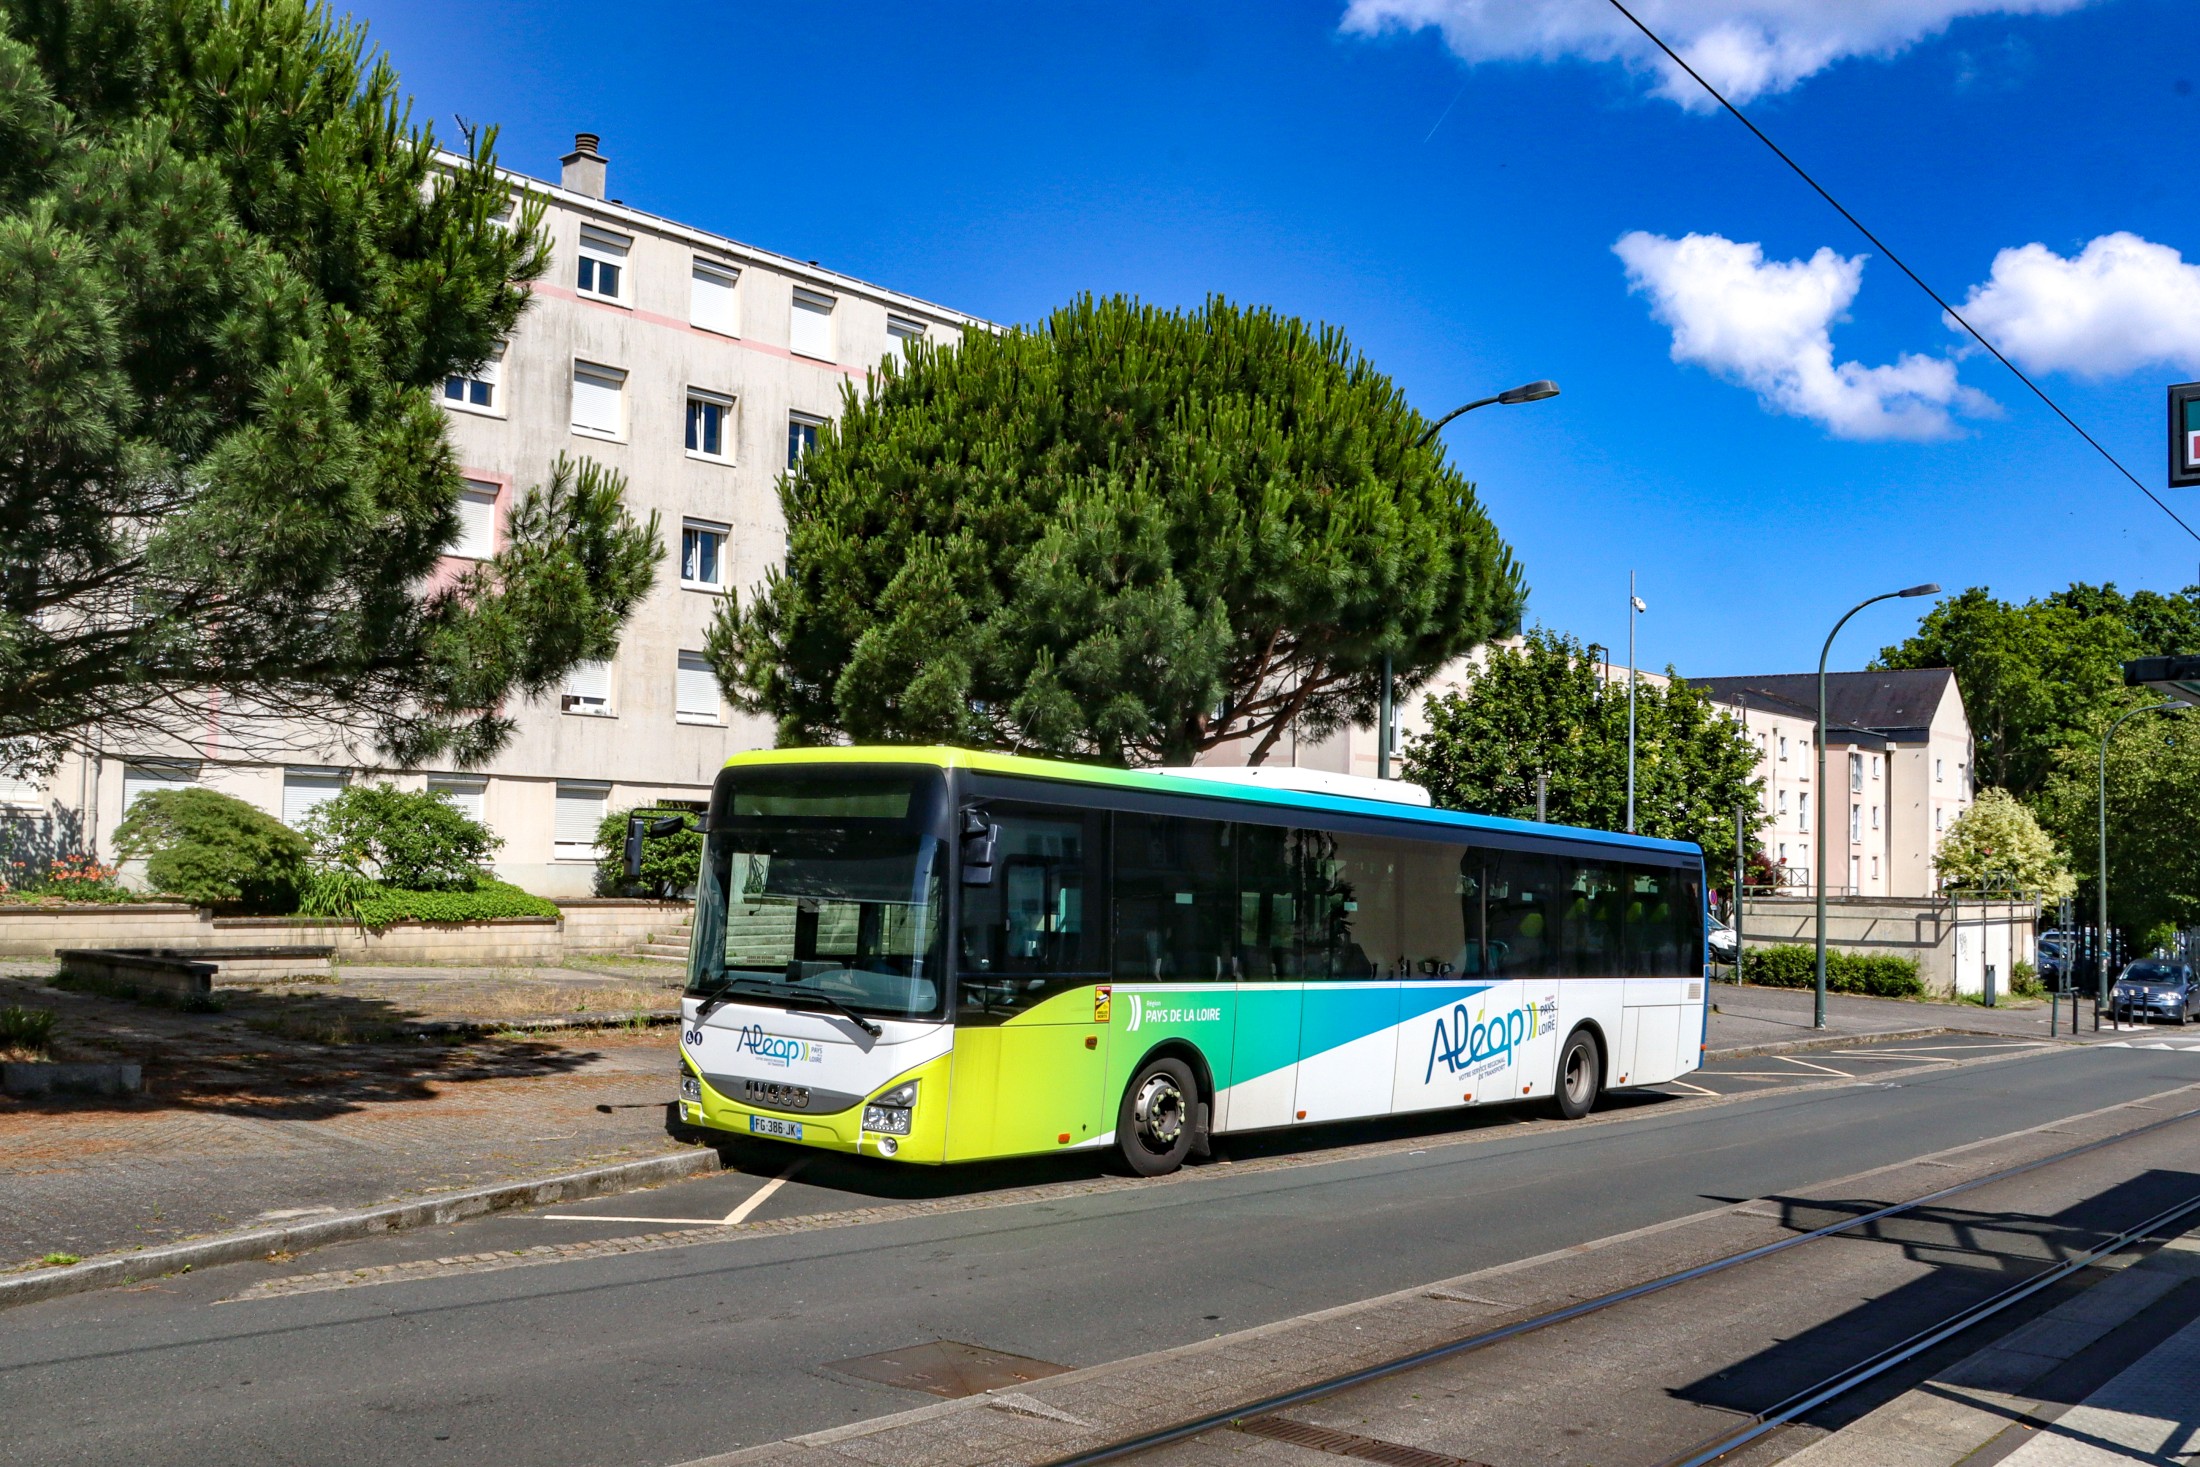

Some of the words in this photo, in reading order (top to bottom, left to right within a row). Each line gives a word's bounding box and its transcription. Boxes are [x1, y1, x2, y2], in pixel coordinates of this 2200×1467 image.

[1146, 1000, 1162, 1008] Région
[1540, 1001, 1555, 1016] PAYS
[1145, 1009, 1168, 1023] PAYS
[1169, 1009, 1182, 1022] DE
[1183, 1008, 1195, 1022] LA
[1196, 1007, 1221, 1021] LOIRE
[1538, 1019, 1555, 1036] LOIRE
[1425, 1003, 1524, 1085] Aléop
[745, 1080, 810, 1109] IVECO
